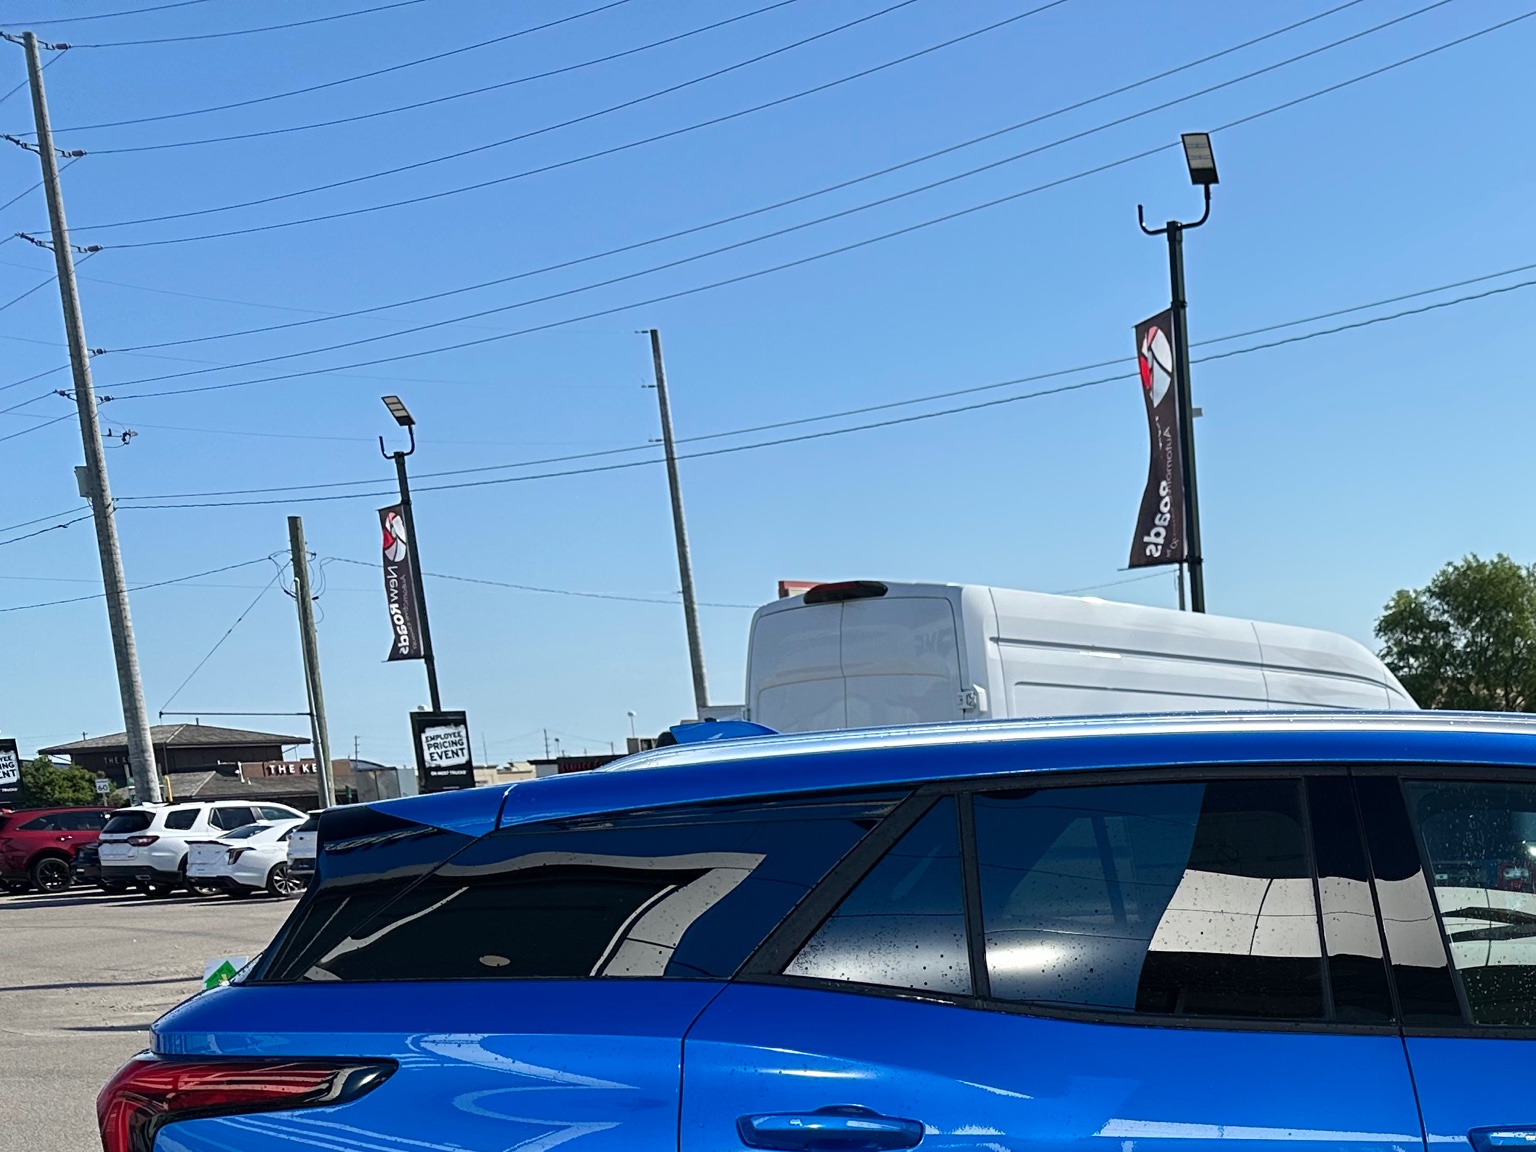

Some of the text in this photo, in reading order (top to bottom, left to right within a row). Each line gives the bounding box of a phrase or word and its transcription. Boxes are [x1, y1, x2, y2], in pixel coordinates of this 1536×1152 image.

[425, 731, 462, 743] EMPLOYEE
[427, 738, 464, 751] PRICING
[103, 756, 119, 765] THE
[429, 748, 466, 762] EVENT
[269, 764, 295, 774] THE
